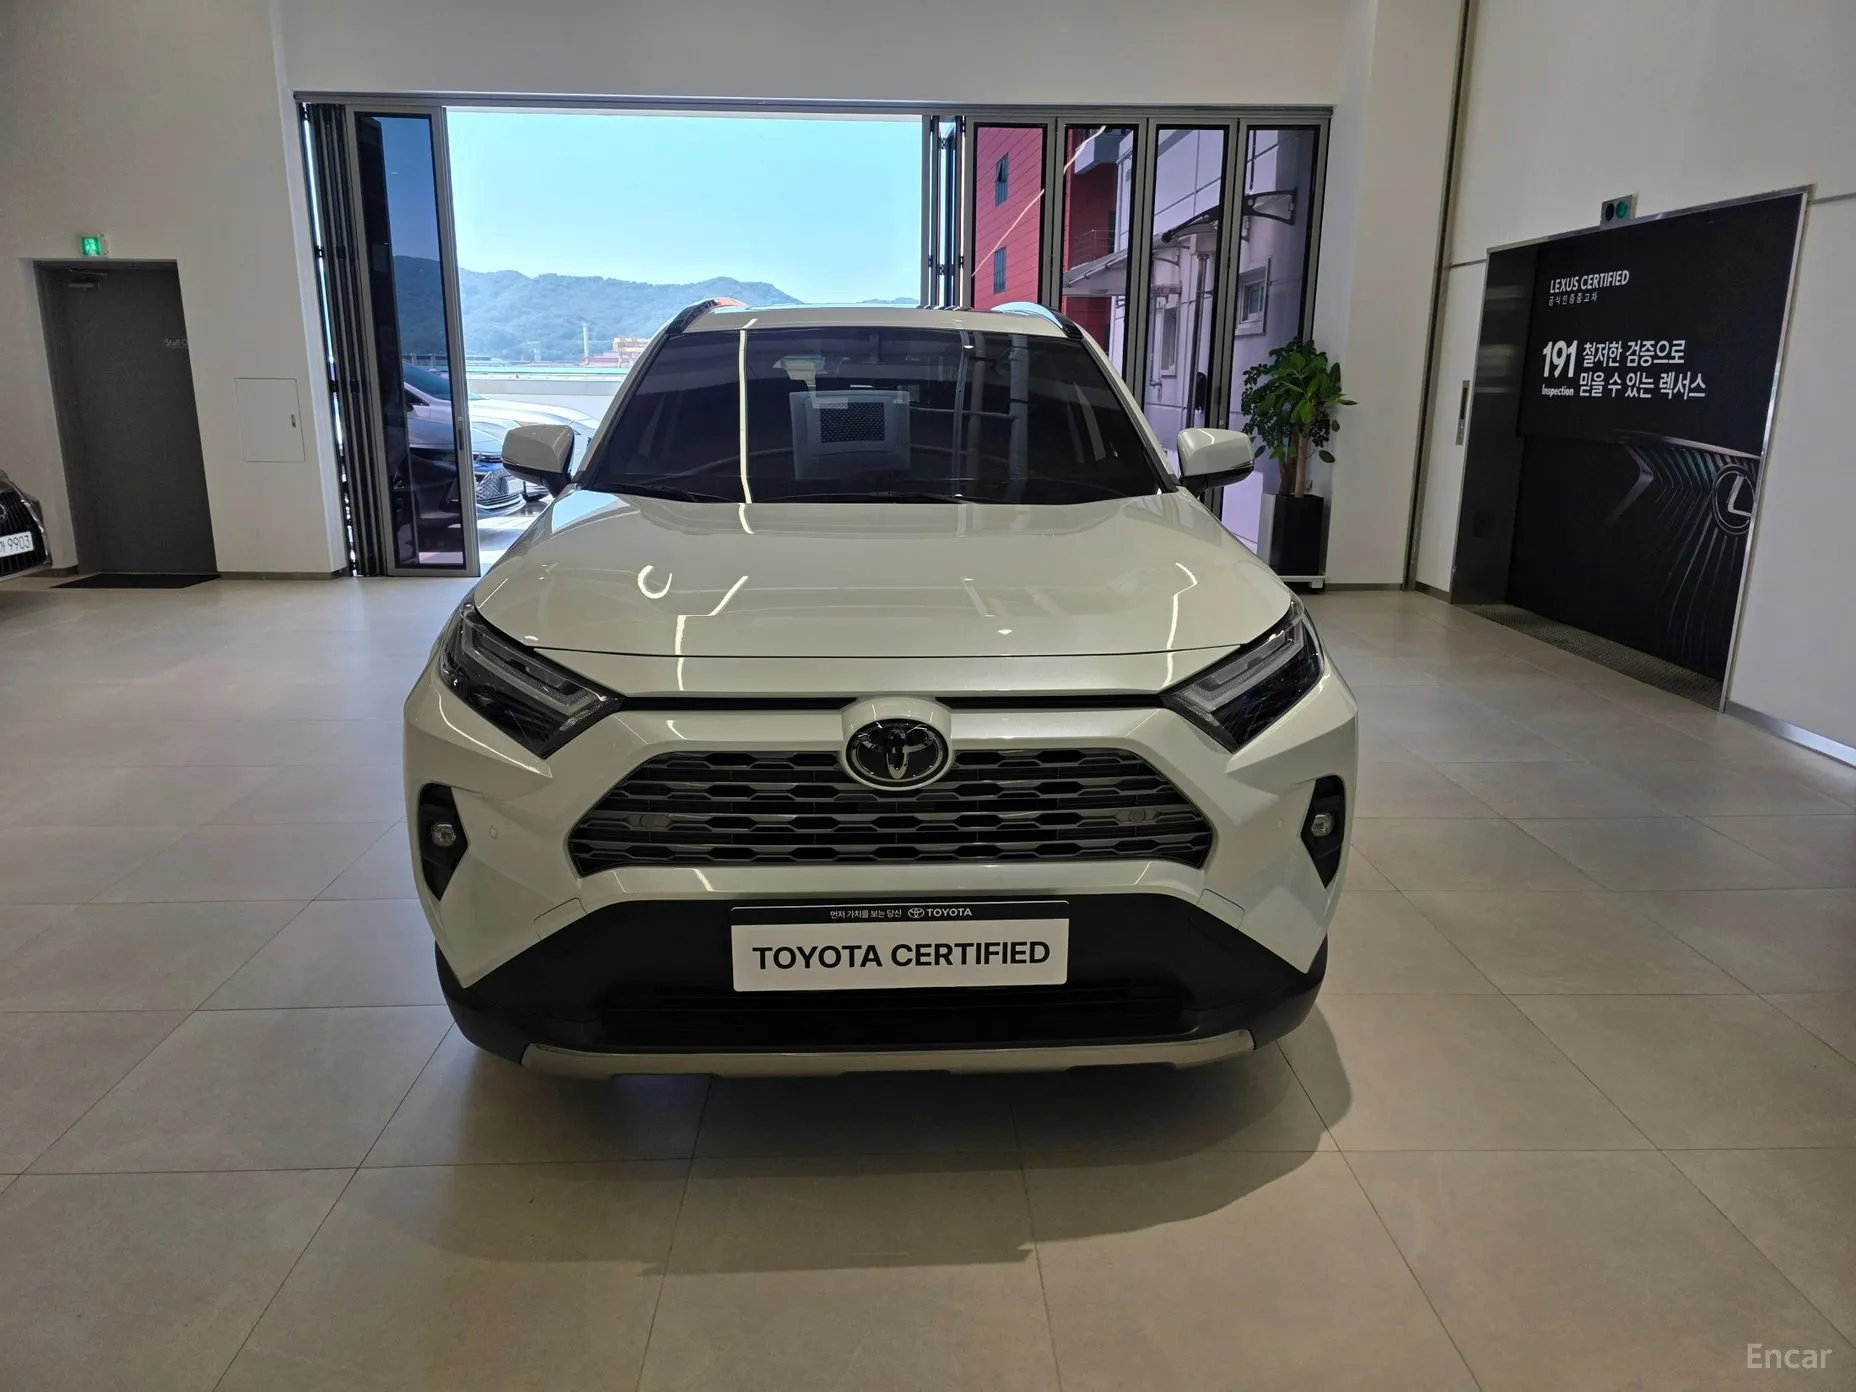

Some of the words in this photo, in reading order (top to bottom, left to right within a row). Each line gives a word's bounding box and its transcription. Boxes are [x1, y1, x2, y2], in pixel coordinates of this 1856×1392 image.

[1550, 276, 1579, 293] LEXUS
[1580, 270, 1630, 290] CERTIFIED
[1542, 340, 1578, 378] 191
[1582, 341, 1623, 368] 철저한
[1626, 340, 1686, 367] 검증으로
[1541, 383, 1574, 397] Inspection
[1579, 371, 1605, 397] 믿을
[1607, 372, 1622, 398] 수
[1625, 371, 1655, 399] 있는
[1659, 371, 1706, 400] 렉서스
[830, 910, 846, 920] 먼저
[847, 909, 869, 919] 가치를
[870, 909, 885, 919] 보는
[886, 908, 902, 918] 당신
[926, 908, 972, 917] TOYOTA
[752, 945, 883, 970] TOYOTA
[890, 941, 1050, 967] CERTIFIED
